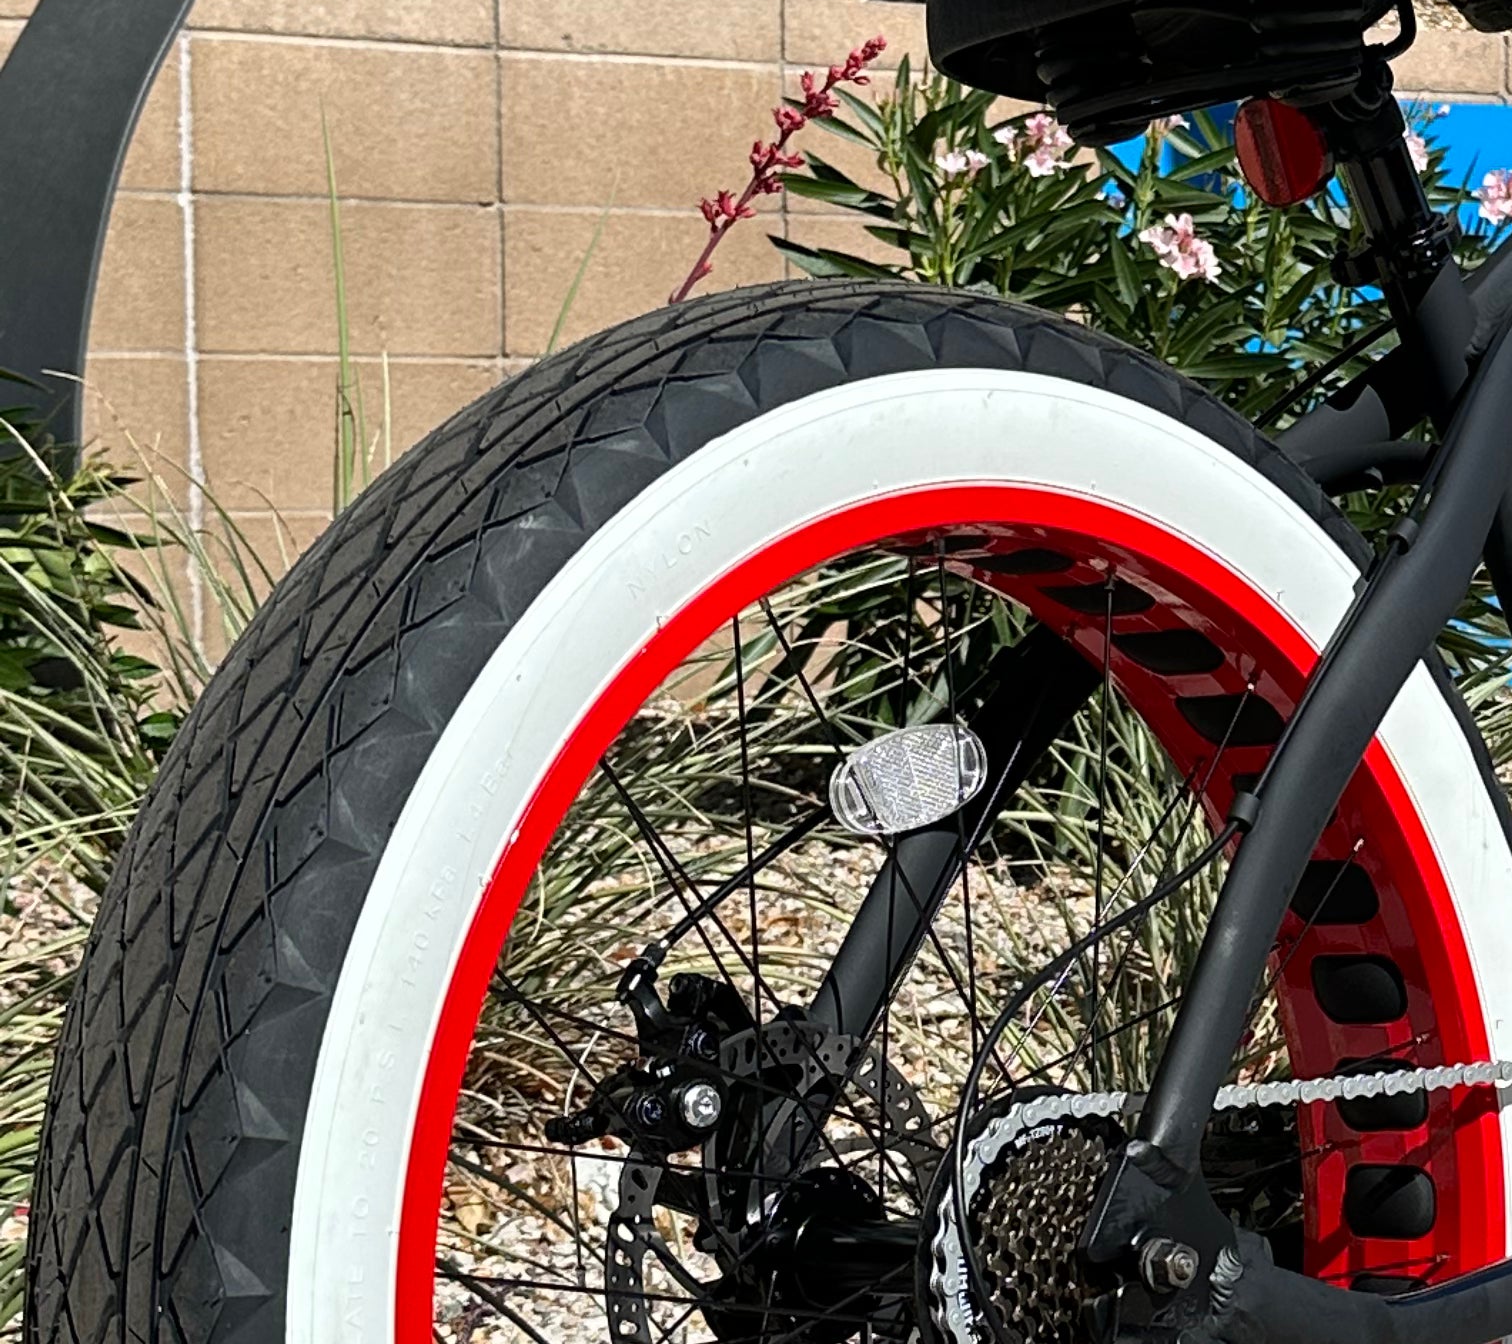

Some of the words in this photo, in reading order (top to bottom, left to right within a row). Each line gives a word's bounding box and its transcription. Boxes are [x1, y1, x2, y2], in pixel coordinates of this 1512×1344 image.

[625, 518, 712, 601] NYLON
[401, 929, 430, 989] 140
[357, 1129, 381, 1171] 20
[349, 1196, 370, 1243] TO
